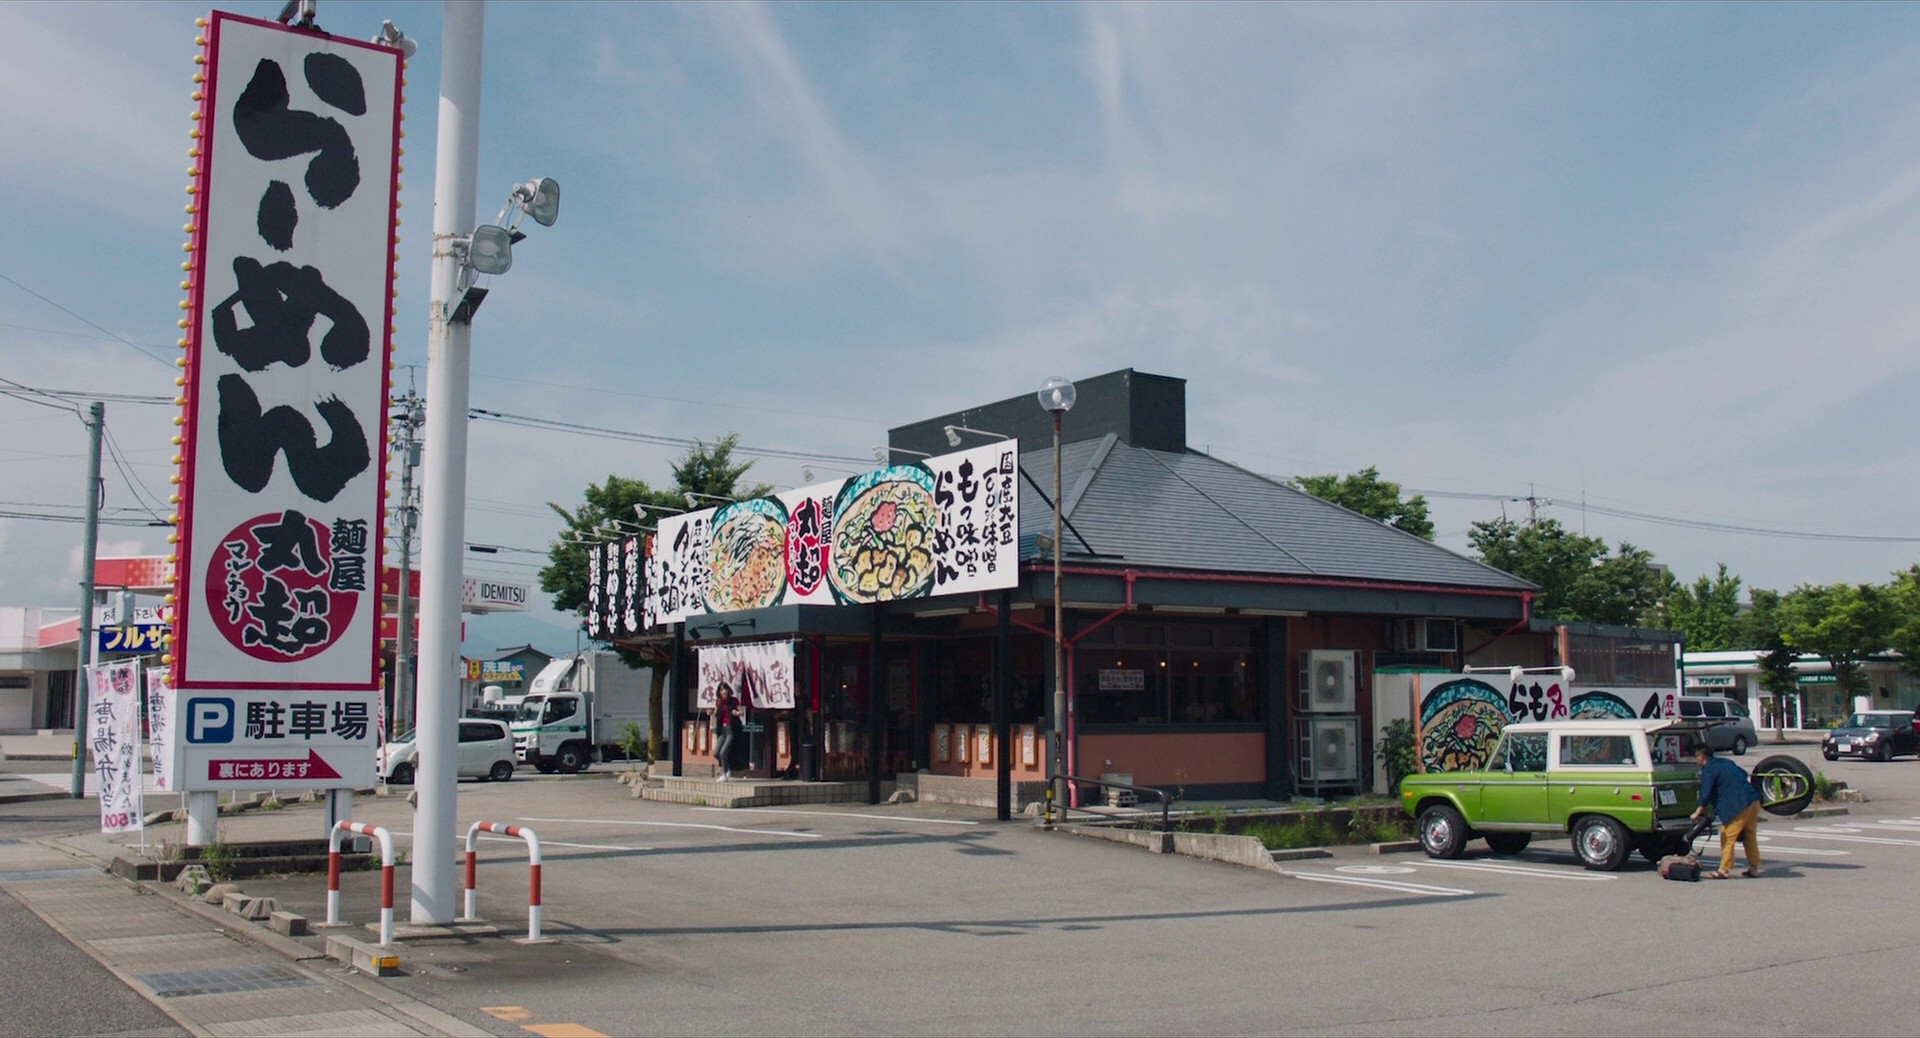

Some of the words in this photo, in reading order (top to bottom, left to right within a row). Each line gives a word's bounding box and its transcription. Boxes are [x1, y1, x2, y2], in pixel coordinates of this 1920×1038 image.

[213, 51, 370, 503] らーめん
[999, 451, 1015, 546] 国産大豆
[224, 540, 255, 624] マルチョウ
[243, 509, 331, 657] 丸超
[328, 517, 367, 592] 麺屋
[481, 583, 526, 603] IDEMITSU
[244, 700, 370, 740] 駐車場
[219, 761, 311, 778] 裏にあります
